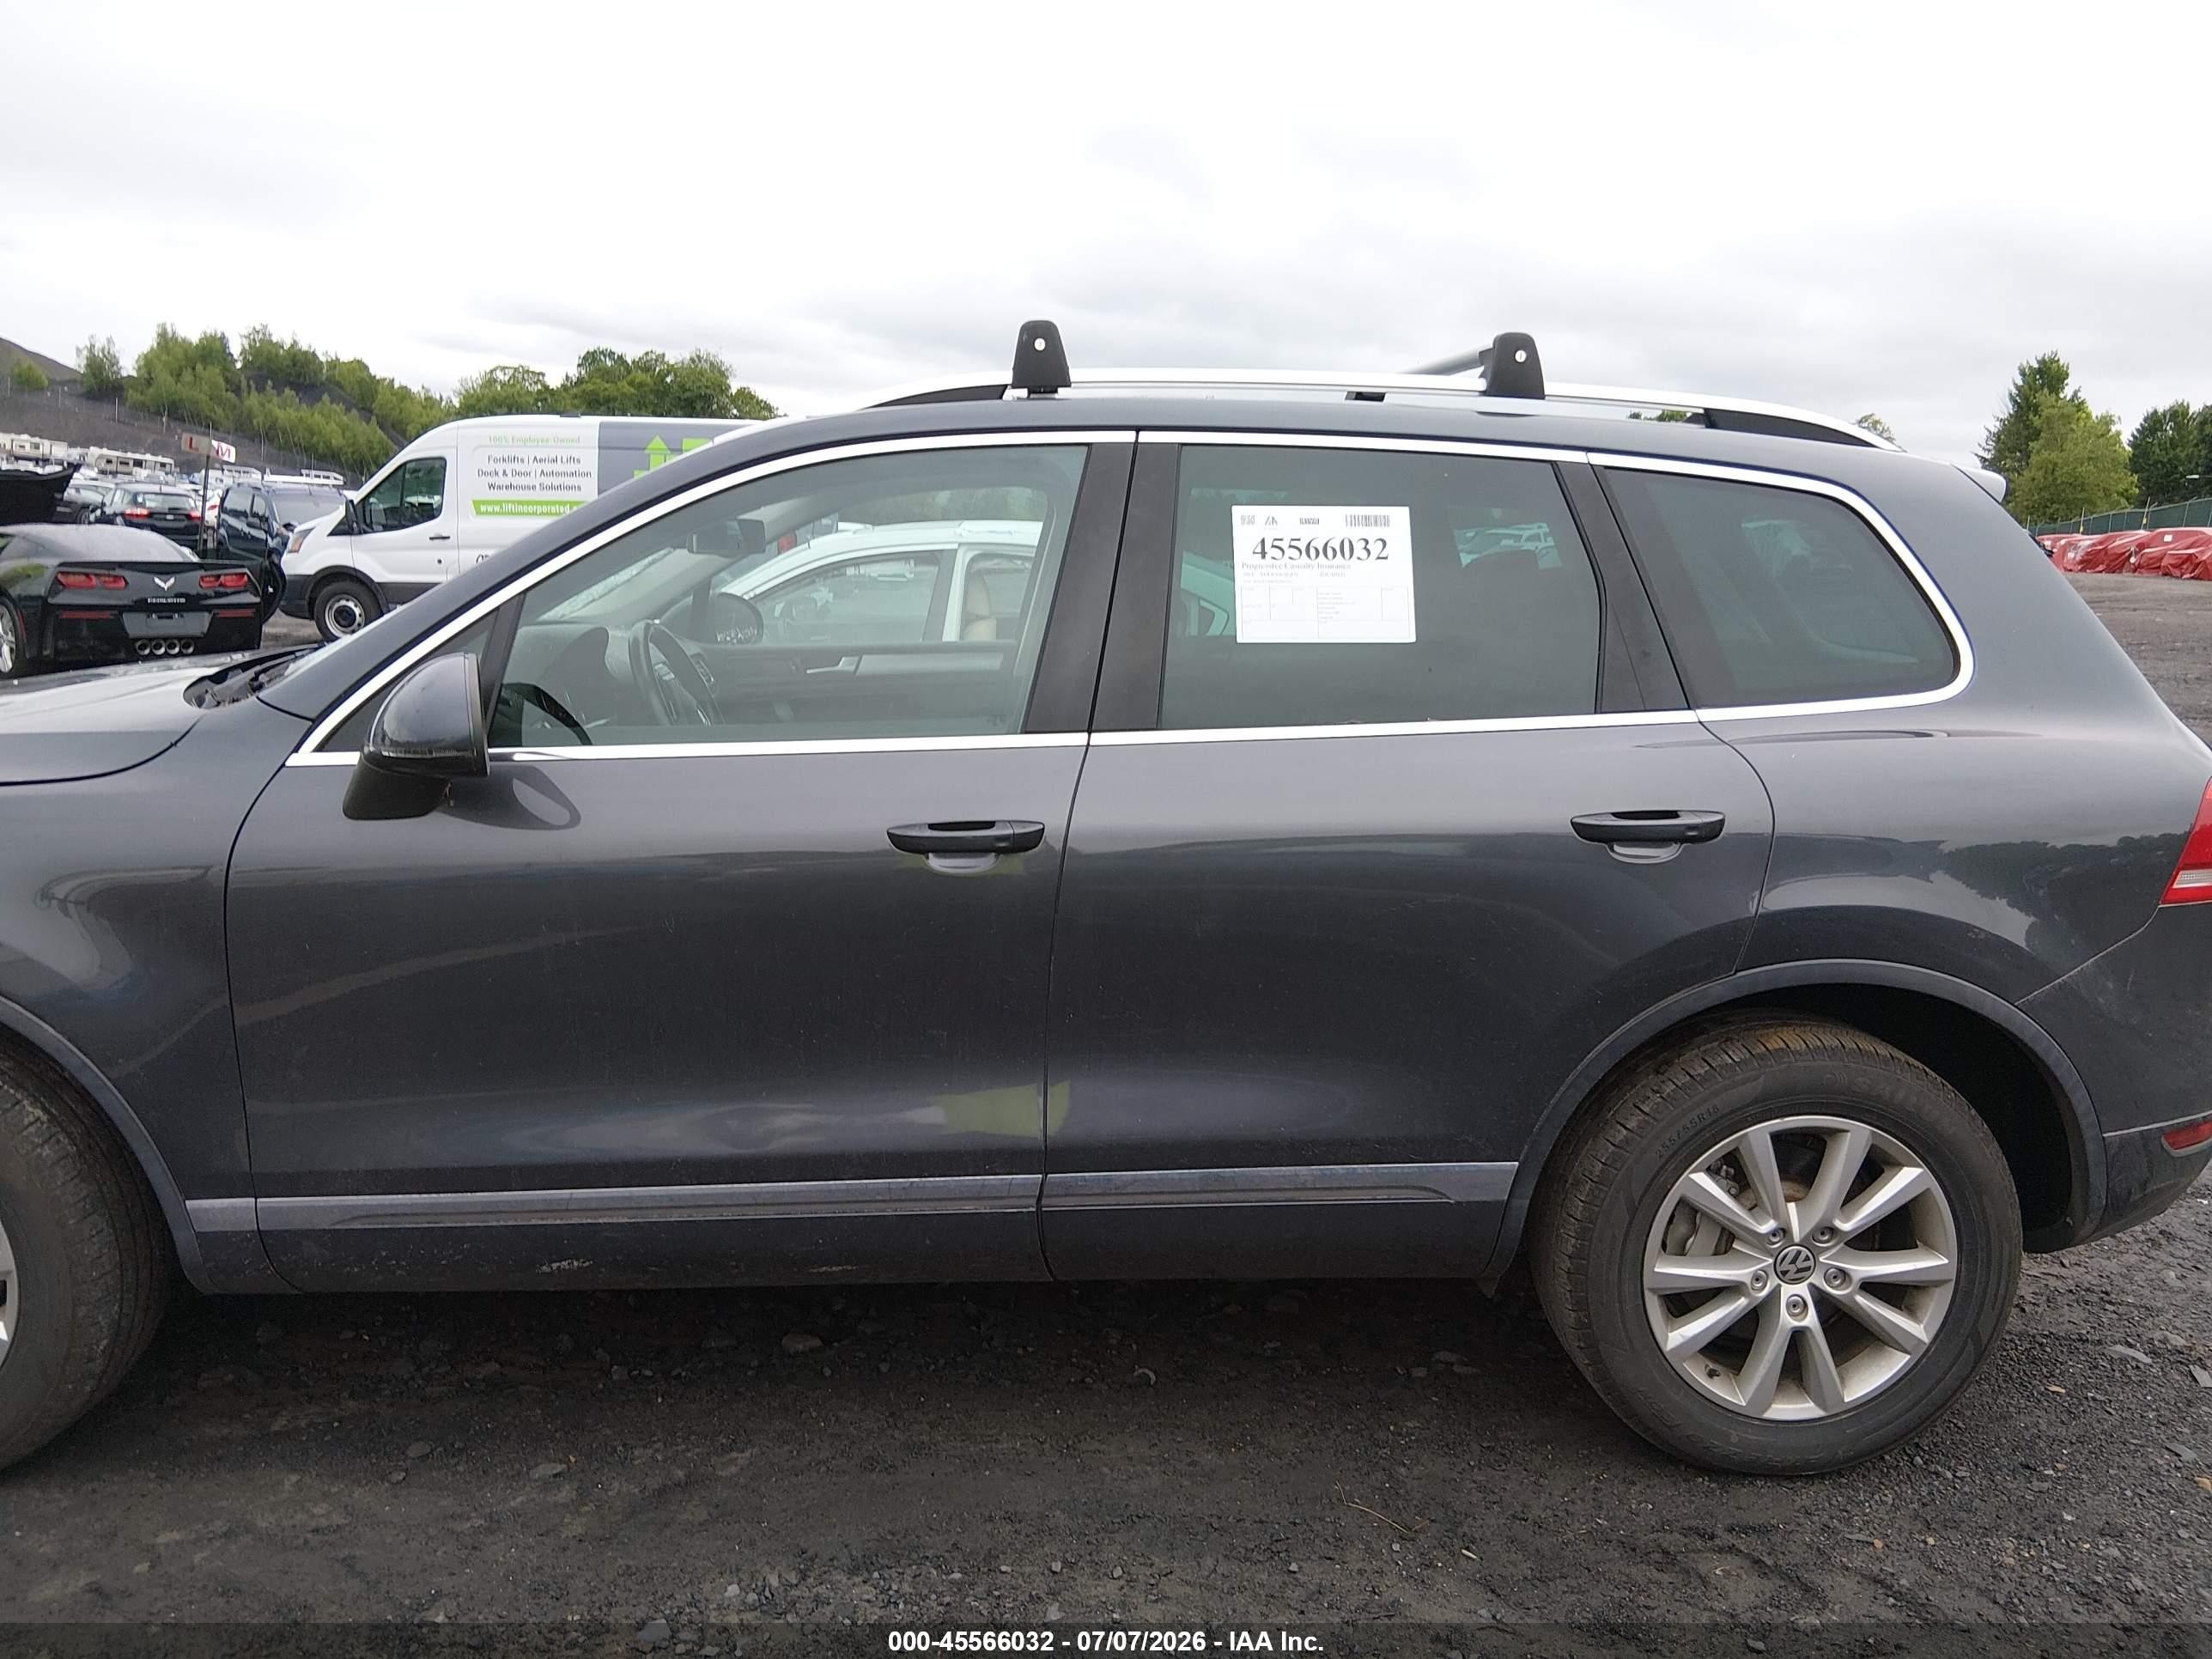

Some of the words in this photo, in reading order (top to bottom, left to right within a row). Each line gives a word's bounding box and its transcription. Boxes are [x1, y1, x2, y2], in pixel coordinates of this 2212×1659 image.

[488, 455, 525, 465] Forklifts
[532, 455, 557, 465] Aerial
[561, 455, 581, 465] Lifts
[477, 469, 499, 478] Dock
[502, 469, 508, 478] &
[511, 469, 532, 478] Door
[539, 469, 592, 478] Automation
[488, 482, 537, 492] Warehouse
[539, 482, 581, 492] Solutions
[480, 502, 577, 515] www.liftincorporated
[1252, 537, 1389, 561] 45566032
